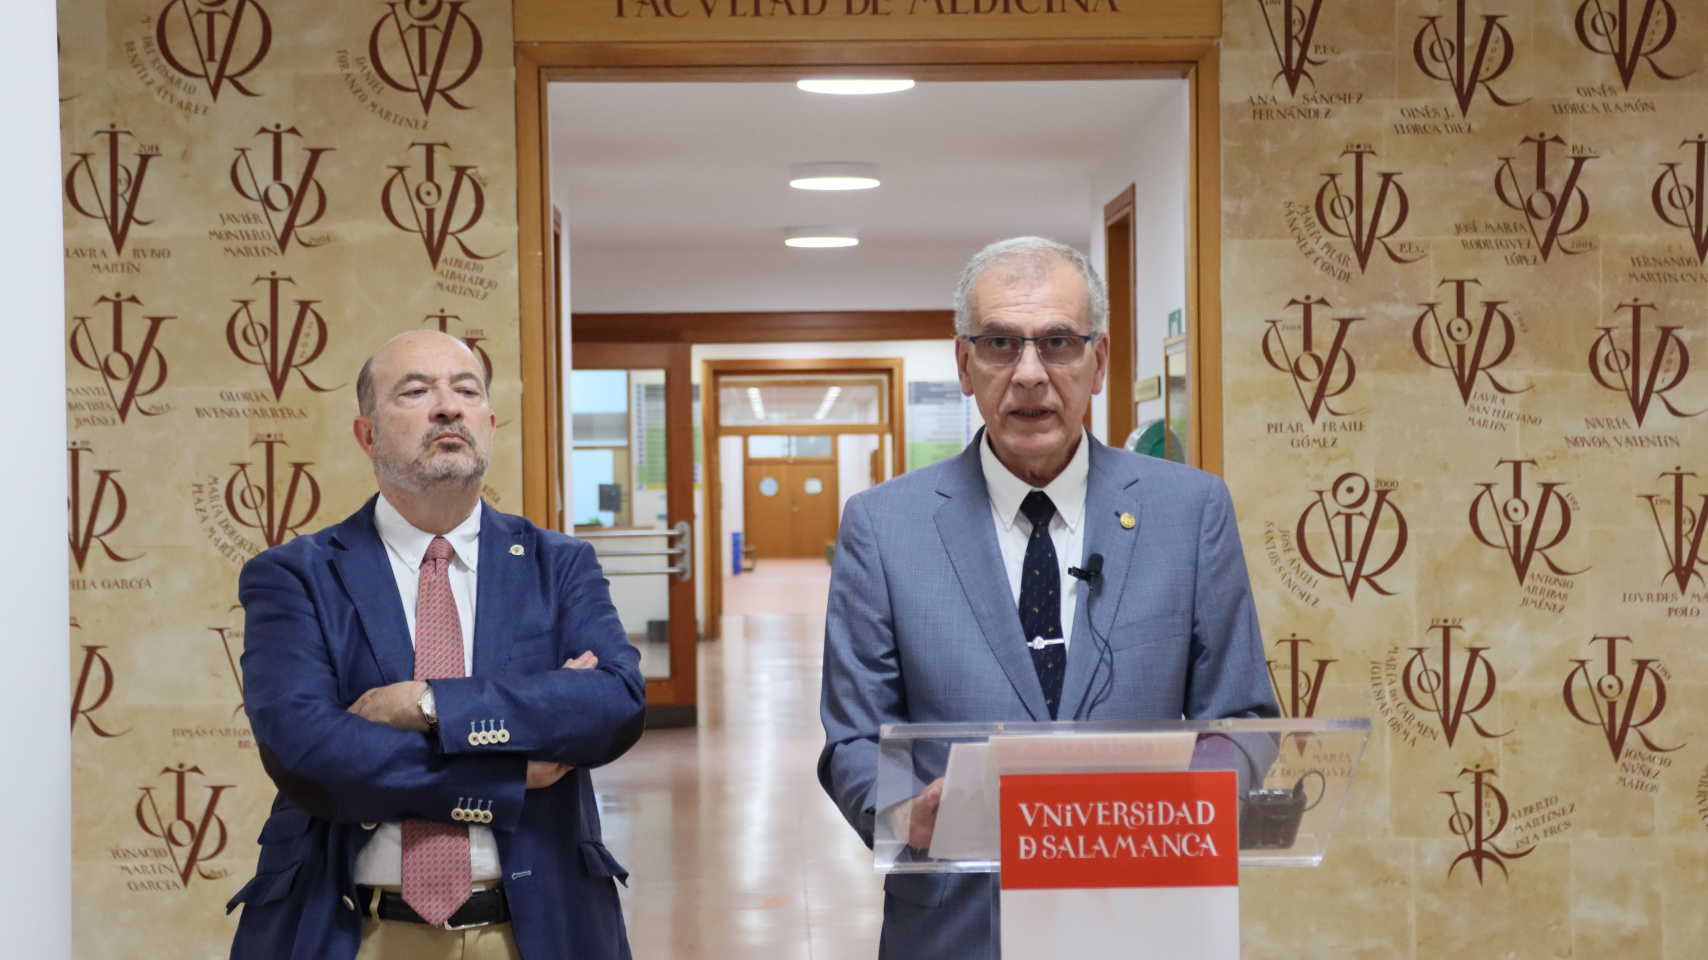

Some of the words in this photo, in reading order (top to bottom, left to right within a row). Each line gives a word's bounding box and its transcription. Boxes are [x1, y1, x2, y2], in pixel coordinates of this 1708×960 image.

[1247, 95, 1278, 106] ANA
[1302, 90, 1364, 105] SÁNCHEZ
[1576, 84, 1617, 98] GINÉS
[1252, 106, 1332, 120] FERNÁNDEZ
[1400, 105, 1441, 118] GINÉS
[1552, 103, 1600, 114] LLORCA
[1602, 98, 1656, 114] RAMÓN
[1394, 124, 1441, 135] LLORCA
[219, 213, 264, 226] JAVIER
[208, 229, 272, 241] MONTERO
[1299, 204, 1323, 245] MARÍA
[1321, 241, 1351, 267] PILAR
[1454, 220, 1479, 236] JOSÉ
[1485, 221, 1528, 234] MARÍA
[1284, 201, 1315, 259] SÁNCHEZ
[1313, 256, 1353, 283] CONDE
[66, 247, 108, 259] LAVRA
[132, 247, 171, 259] RVBIO
[223, 245, 280, 257] MARTÍN
[442, 257, 485, 274] ALBERTO
[1504, 252, 1540, 266] LÓPEZ
[1630, 255, 1698, 267] FERNANDO
[91, 261, 141, 274] MARTÍN
[438, 269, 499, 290] ALBALADEJO
[1628, 272, 1679, 283] MARTÍN
[435, 281, 489, 301] MARTÍNEZ
[219, 390, 270, 403] GLORIA
[1472, 391, 1506, 406] LAVRA
[194, 407, 241, 418] BVENO
[242, 406, 308, 419] CARRERA
[1469, 403, 1490, 416] SAN
[1492, 408, 1543, 427] FELICIANO
[1466, 416, 1509, 432] MARTÍN
[1290, 435, 1339, 450] GÓMEZ
[1563, 435, 1611, 448] NOVOA
[1612, 434, 1682, 448] VALENTÍN
[191, 482, 210, 525] PLAZA
[208, 475, 224, 519] MARÍA
[1278, 526, 1296, 556] JOSÉ
[1264, 520, 1281, 567] SANTOS
[1275, 565, 1320, 608] SÁNCHEZ
[101, 577, 153, 590] GARCÍA
[1529, 572, 1575, 590] ANTONIO
[1525, 584, 1569, 602] ARRIBAS
[1622, 591, 1678, 603] LOVRDES
[1518, 596, 1566, 614] JIMÉNEZ
[1668, 606, 1700, 618] POLO
[1385, 644, 1400, 687] MARÍA
[1396, 702, 1440, 741] CARMEN
[171, 726, 207, 738] TOMÁS
[1388, 717, 1418, 748] OSMA
[1624, 749, 1673, 768] IGNACIO
[1616, 775, 1660, 794] MATEOS
[1509, 795, 1559, 821] ALBERTO
[1514, 802, 1576, 833] MARTÍNEZ
[1042, 833, 1219, 859] SALAMANCA
[110, 848, 169, 860] IGNACIO
[119, 863, 175, 876] MARTÍN
[127, 879, 182, 892] GARCÍA
